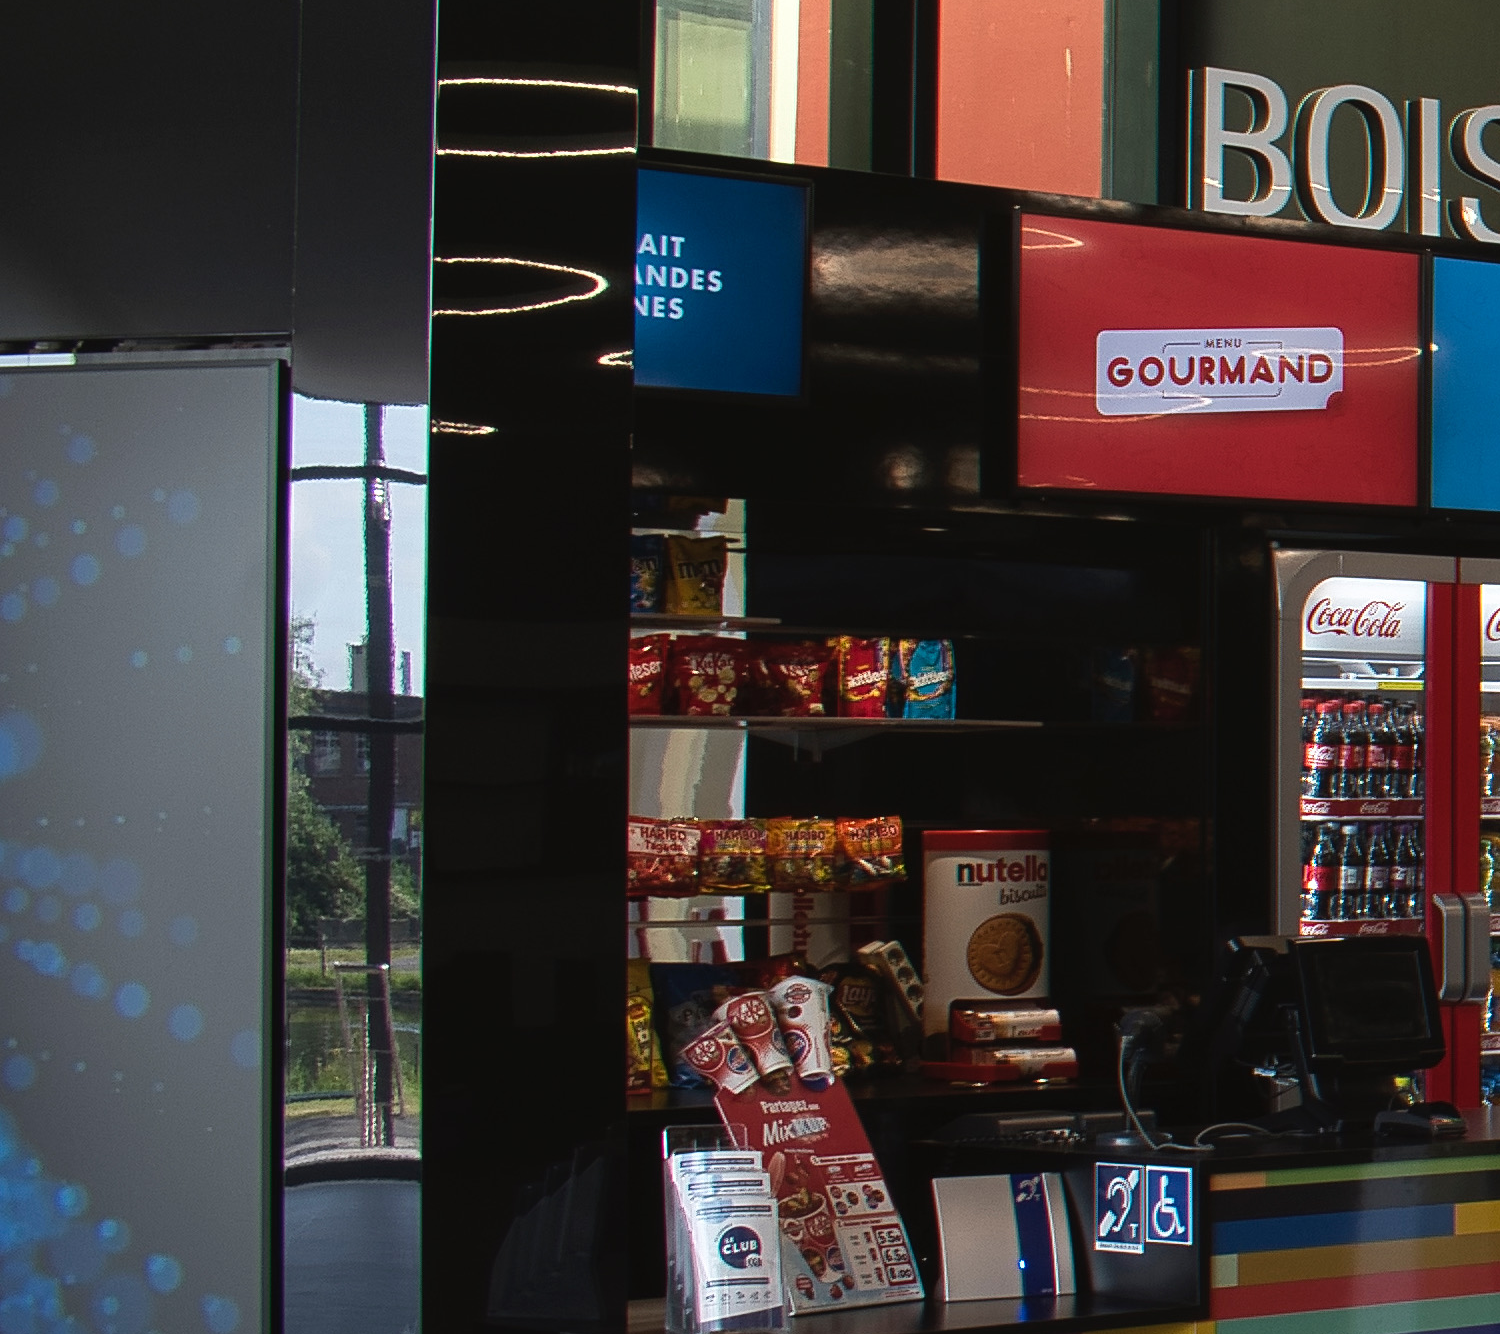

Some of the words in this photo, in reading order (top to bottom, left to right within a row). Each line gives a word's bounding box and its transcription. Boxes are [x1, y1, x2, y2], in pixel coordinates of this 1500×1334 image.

[1205, 338, 1243, 349] MENU
[1107, 353, 1334, 388] GOURMAND
[1306, 597, 1407, 639] Coca-Cola
[722, 1240, 759, 1255] CLUB
